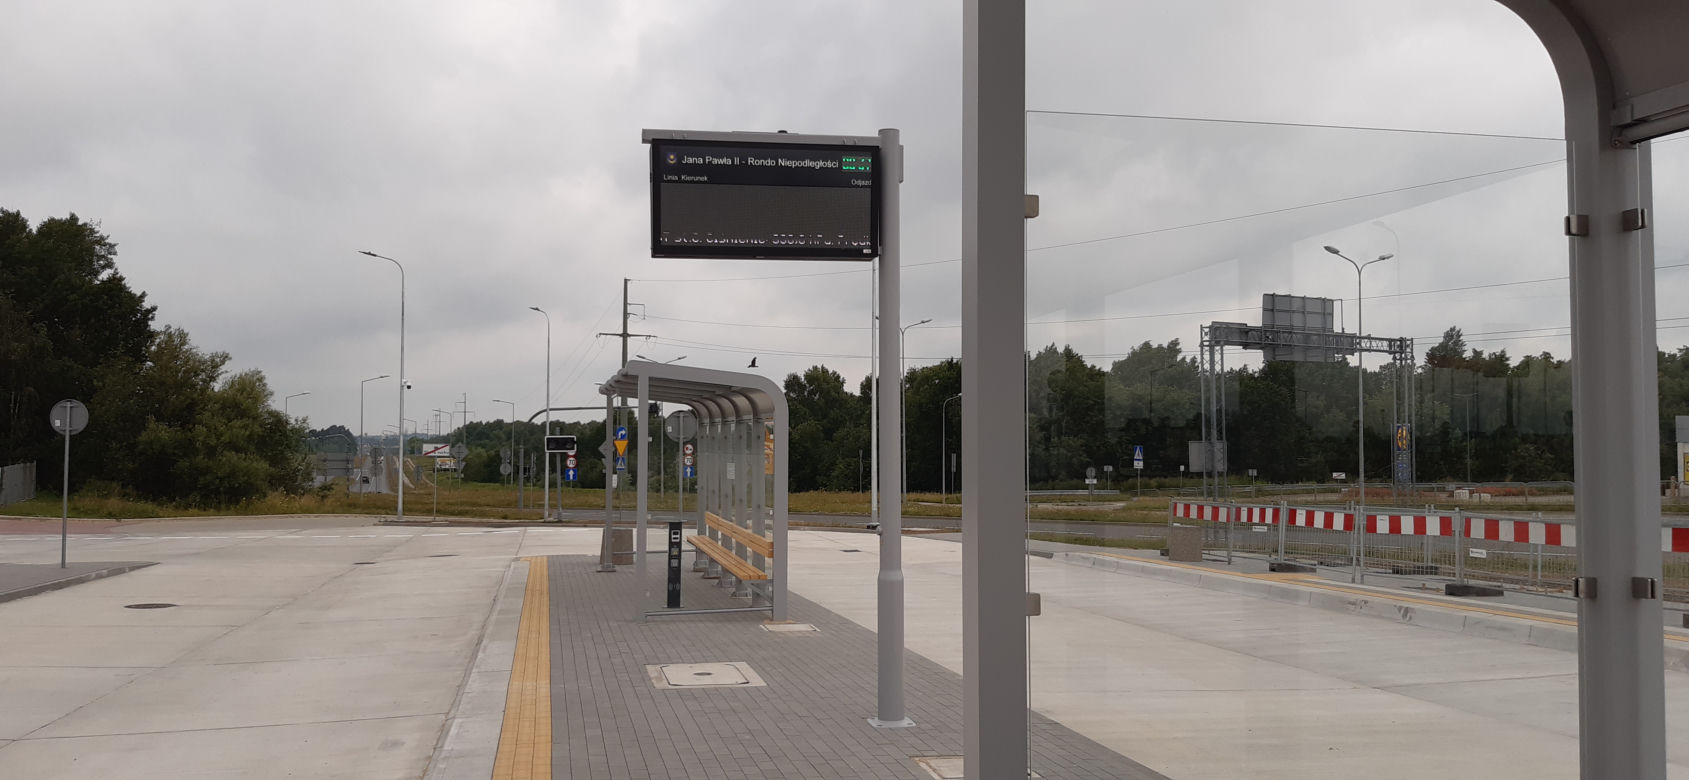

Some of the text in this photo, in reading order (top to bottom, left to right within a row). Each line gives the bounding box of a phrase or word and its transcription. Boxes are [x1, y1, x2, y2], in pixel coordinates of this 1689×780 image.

[681, 155, 703, 164] Jana
[705, 155, 732, 165] Pawła
[747, 157, 776, 167] Rondo
[778, 157, 839, 170] Niepodległości
[663, 173, 679, 181] Linia
[681, 174, 708, 182] Kierunek
